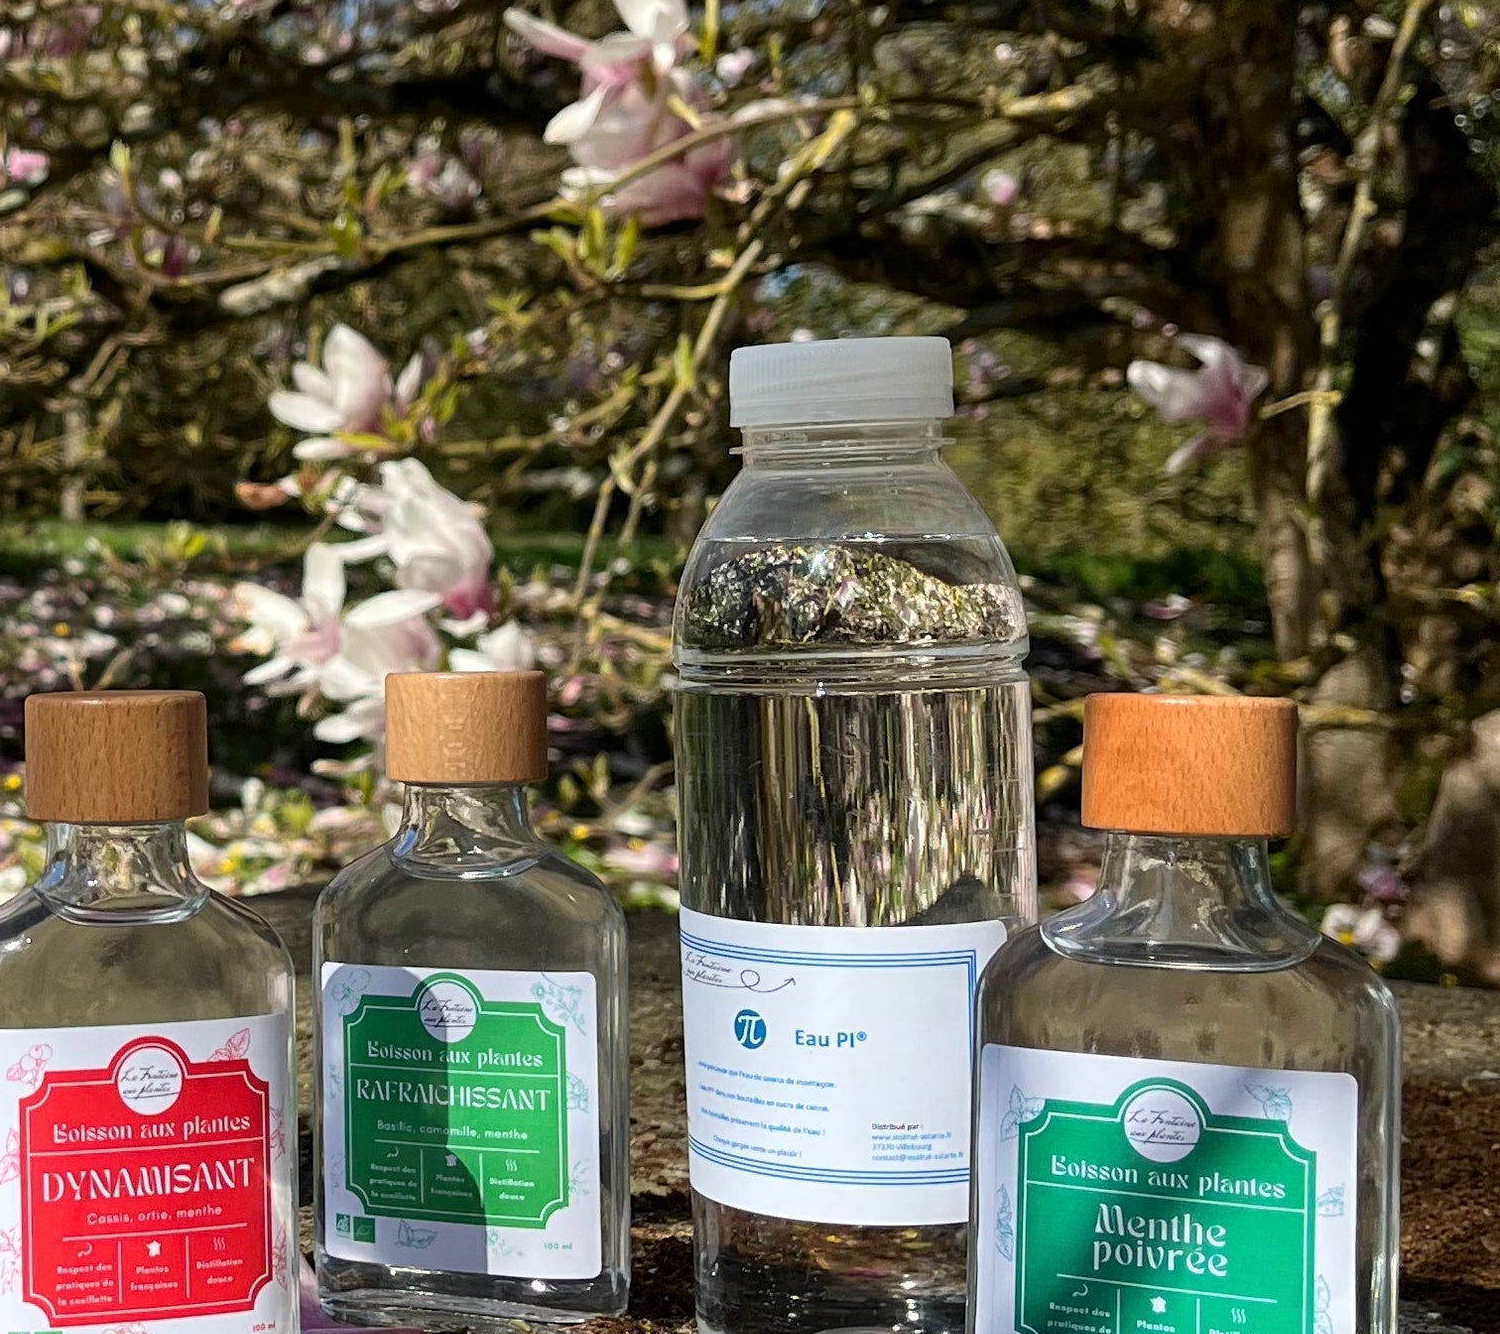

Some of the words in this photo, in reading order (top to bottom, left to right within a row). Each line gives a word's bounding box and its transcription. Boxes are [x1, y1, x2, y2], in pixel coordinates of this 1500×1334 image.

[795, 1029, 829, 1047] Eau
[367, 1040, 432, 1061] Boisson
[439, 1049, 470, 1064] aux
[477, 1048, 543, 1069] plantes
[356, 1078, 551, 1111] RAFRAICHISSANT
[1150, 1110, 1197, 1128] Fontaine
[53, 1123, 133, 1144] Boisson
[140, 1122, 175, 1138] aux
[183, 1115, 250, 1141] plantes
[377, 1119, 416, 1134] Basilic,
[419, 1124, 480, 1139] camomille,
[484, 1128, 528, 1140] menthe
[907, 1123, 919, 1131] par
[42, 1157, 255, 1202] DYNAMISANT
[489, 1177, 535, 1188] Distillation
[1051, 1154, 1138, 1184] Boisson
[1147, 1169, 1188, 1189] aux
[1199, 1172, 1286, 1199] plantes
[499, 1192, 525, 1201] douce
[87, 1212, 133, 1226] Cassis,
[138, 1209, 172, 1222] ortie,
[176, 1204, 223, 1218] menthe
[1095, 1203, 1226, 1247] Menthe
[544, 1242, 559, 1250] 100
[562, 1242, 573, 1250] ml
[196, 1258, 243, 1270] Distillation
[1093, 1240, 1228, 1277] poivrée
[57, 1264, 94, 1276] Respect
[96, 1263, 113, 1272] des
[136, 1266, 169, 1275] Plantes
[56, 1281, 100, 1292] pratiques
[102, 1279, 114, 1288] de
[130, 1281, 178, 1292] françaises
[207, 1275, 233, 1285] douce
[1049, 1302, 1089, 1316] Respect
[252, 1323, 266, 1332] 100
[267, 1320, 276, 1329] ml
[1047, 1319, 1096, 1334] pratiques
[1099, 1325, 1112, 1334] de
[1136, 1319, 1175, 1333] Plantes
